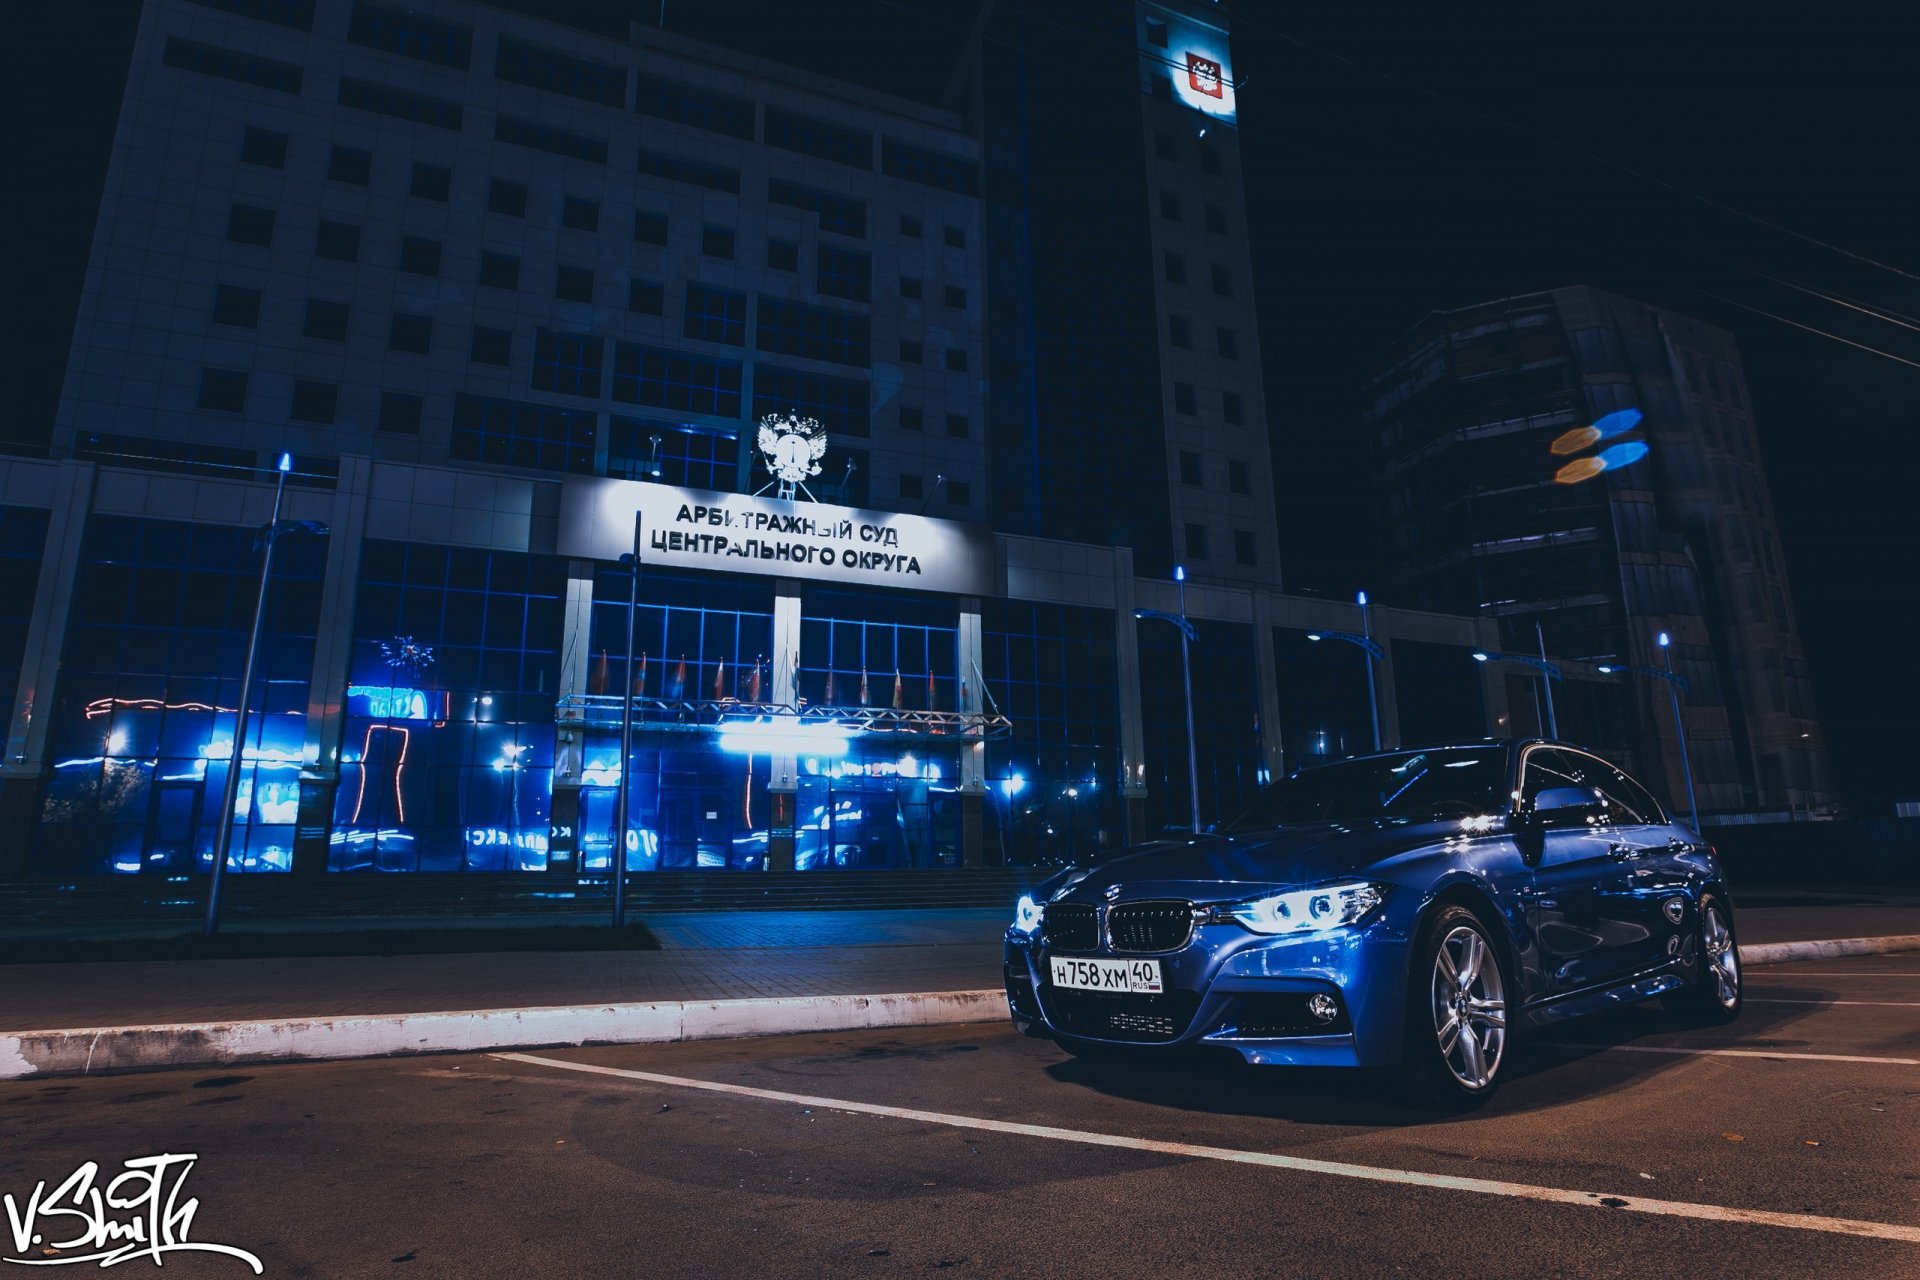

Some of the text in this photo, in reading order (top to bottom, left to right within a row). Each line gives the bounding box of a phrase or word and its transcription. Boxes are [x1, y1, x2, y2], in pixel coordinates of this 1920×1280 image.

[676, 503, 899, 549] АРБИТРАЖНЫЙ СУД
[651, 529, 922, 575] ЦЕНТРАЛЬНОГО ОКРУГА
[1132, 982, 1149, 990] RUS
